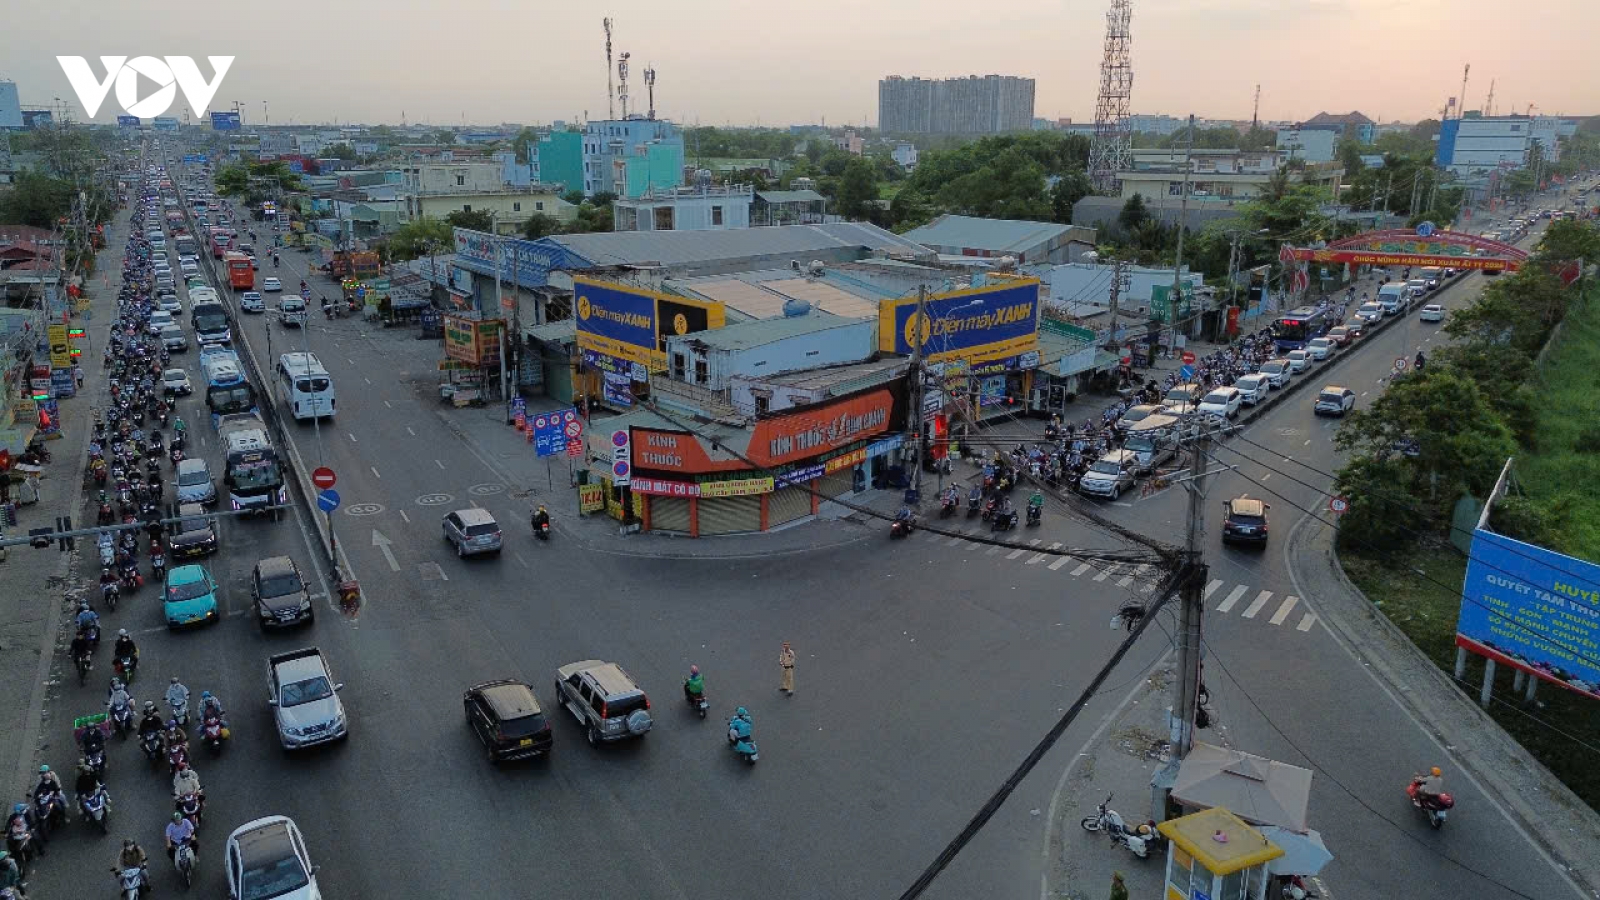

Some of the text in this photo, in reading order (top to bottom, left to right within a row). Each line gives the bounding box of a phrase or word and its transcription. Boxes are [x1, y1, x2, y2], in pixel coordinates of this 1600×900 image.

[1353, 255, 1375, 263] CHÚC
[1377, 255, 1400, 264] MỪNG
[1401, 256, 1419, 265] NĂM
[1420, 257, 1436, 266] MỚI
[1438, 258, 1460, 267] XUÂN
[647, 434, 678, 448] KÍNH
[770, 433, 793, 457] KÍNH
[795, 422, 825, 451] THUỐC
[641, 451, 683, 468] THUỐC
[630, 477, 651, 492] KÍNH
[1486, 574, 1531, 595] QUYẾT
[1534, 589, 1565, 607] TÂM
[1553, 580, 1600, 606] HUYỆ
